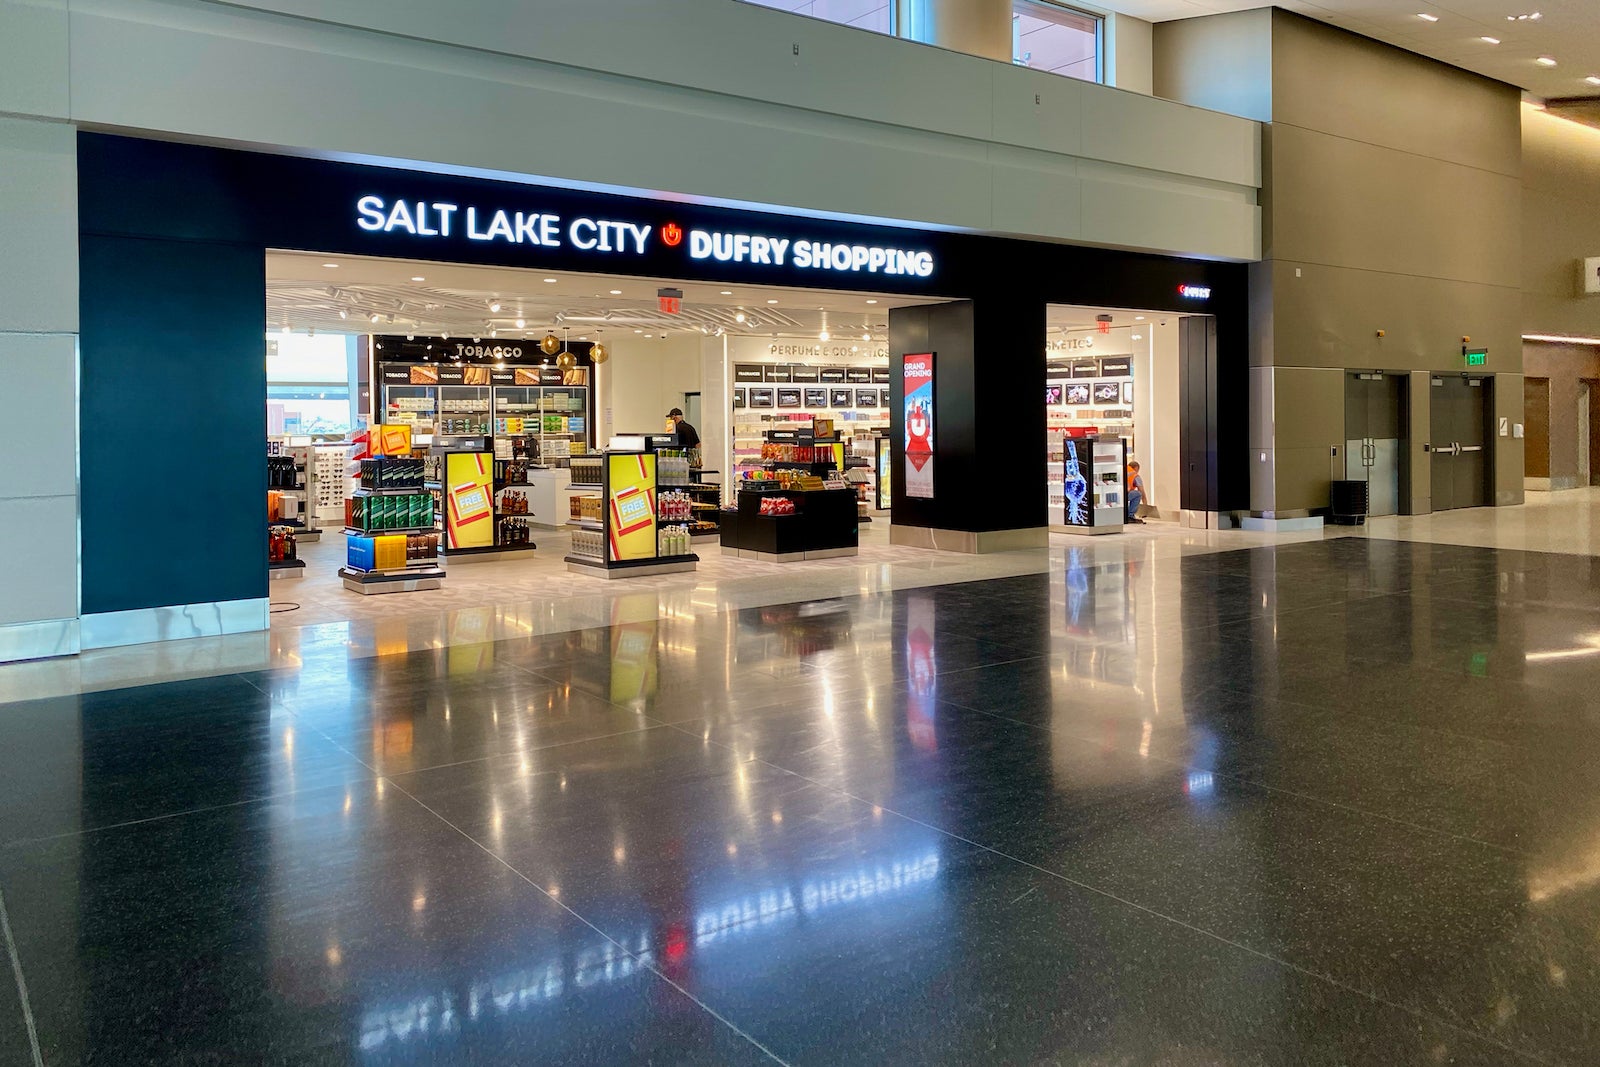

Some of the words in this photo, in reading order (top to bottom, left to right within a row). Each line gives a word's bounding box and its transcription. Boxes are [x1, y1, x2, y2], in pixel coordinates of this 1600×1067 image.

[357, 195, 457, 236] SALT
[467, 206, 561, 247] LAKE
[569, 218, 652, 254] CITY
[689, 230, 789, 265] DUFRY
[793, 240, 934, 277] SHOPPING
[457, 344, 522, 359] TOBACCO
[770, 345, 819, 355] PERFUME
[904, 362, 925, 371] GRAND
[1469, 353, 1485, 366] EXIT
[904, 369, 932, 378] OPENING
[459, 491, 484, 509] FREE
[621, 499, 645, 515] FREE
